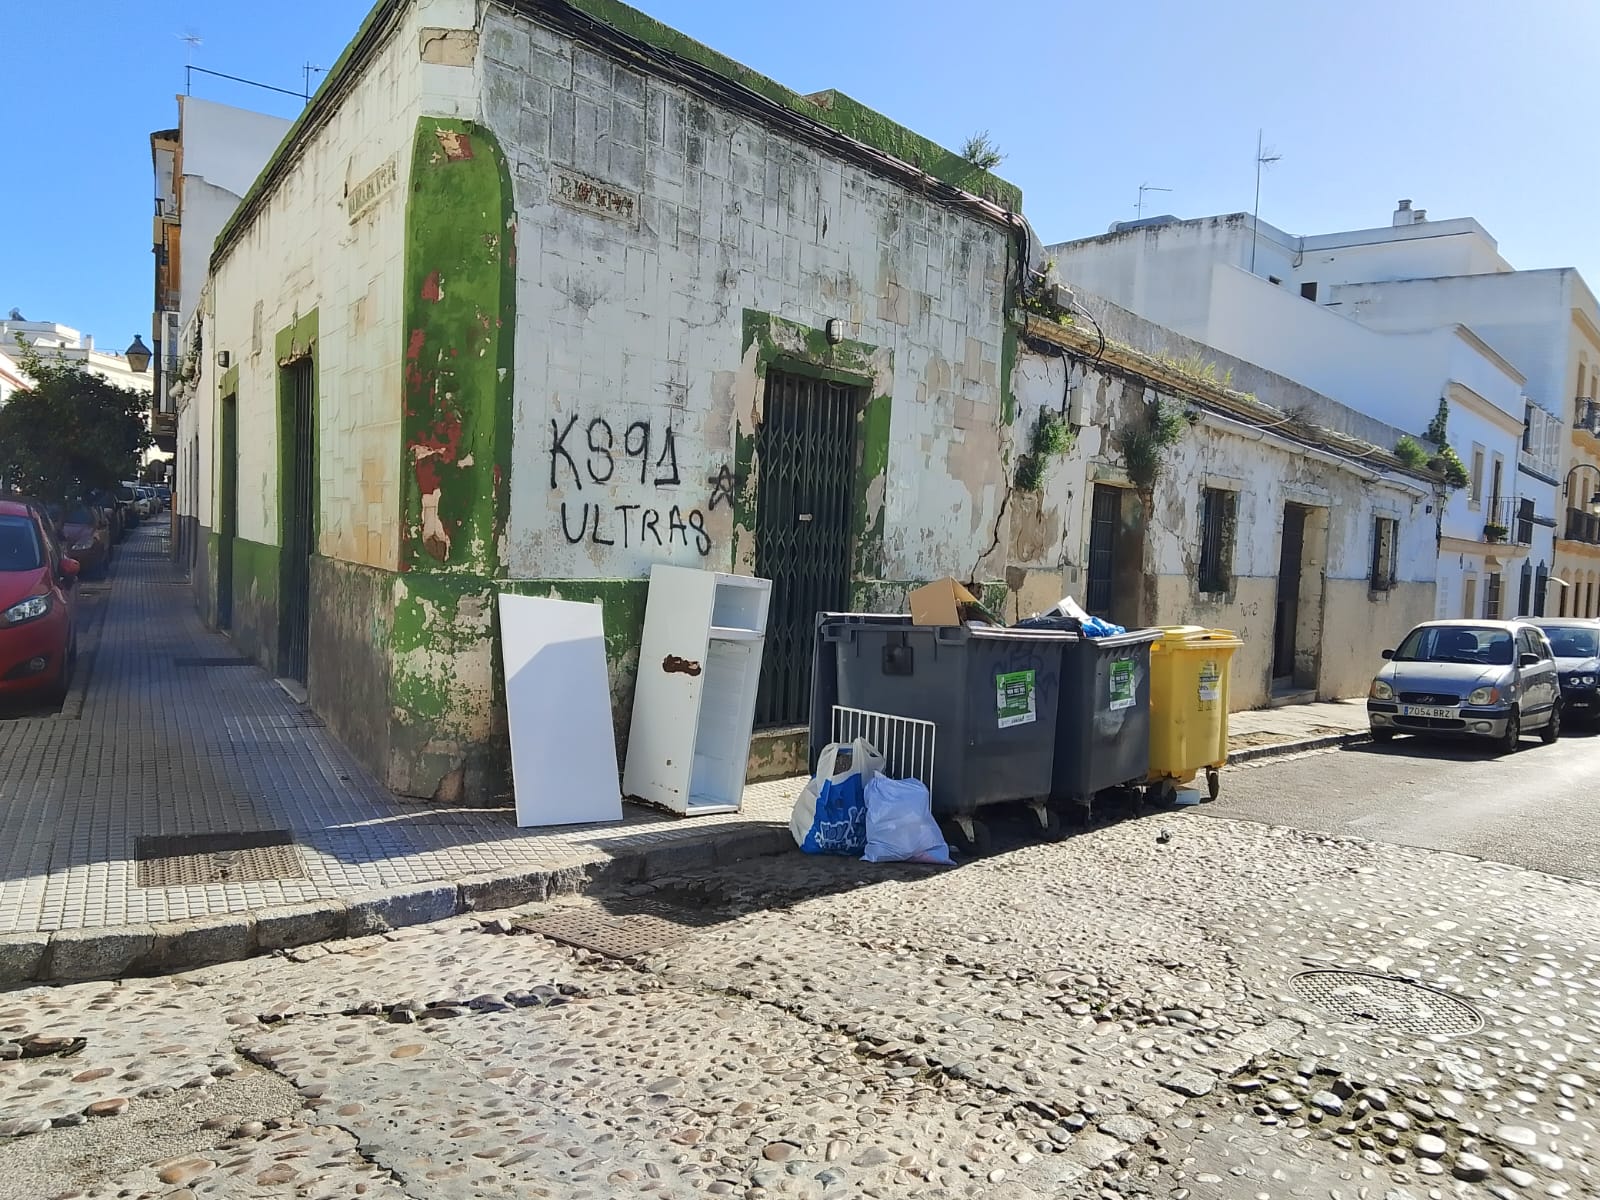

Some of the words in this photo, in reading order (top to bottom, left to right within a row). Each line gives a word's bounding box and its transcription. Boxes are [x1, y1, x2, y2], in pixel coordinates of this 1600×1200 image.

[550, 414, 681, 490] KS91
[560, 502, 712, 556] ULTRAS
[1408, 706, 1431, 716] 7054
[1433, 707, 1451, 718] BRZ
